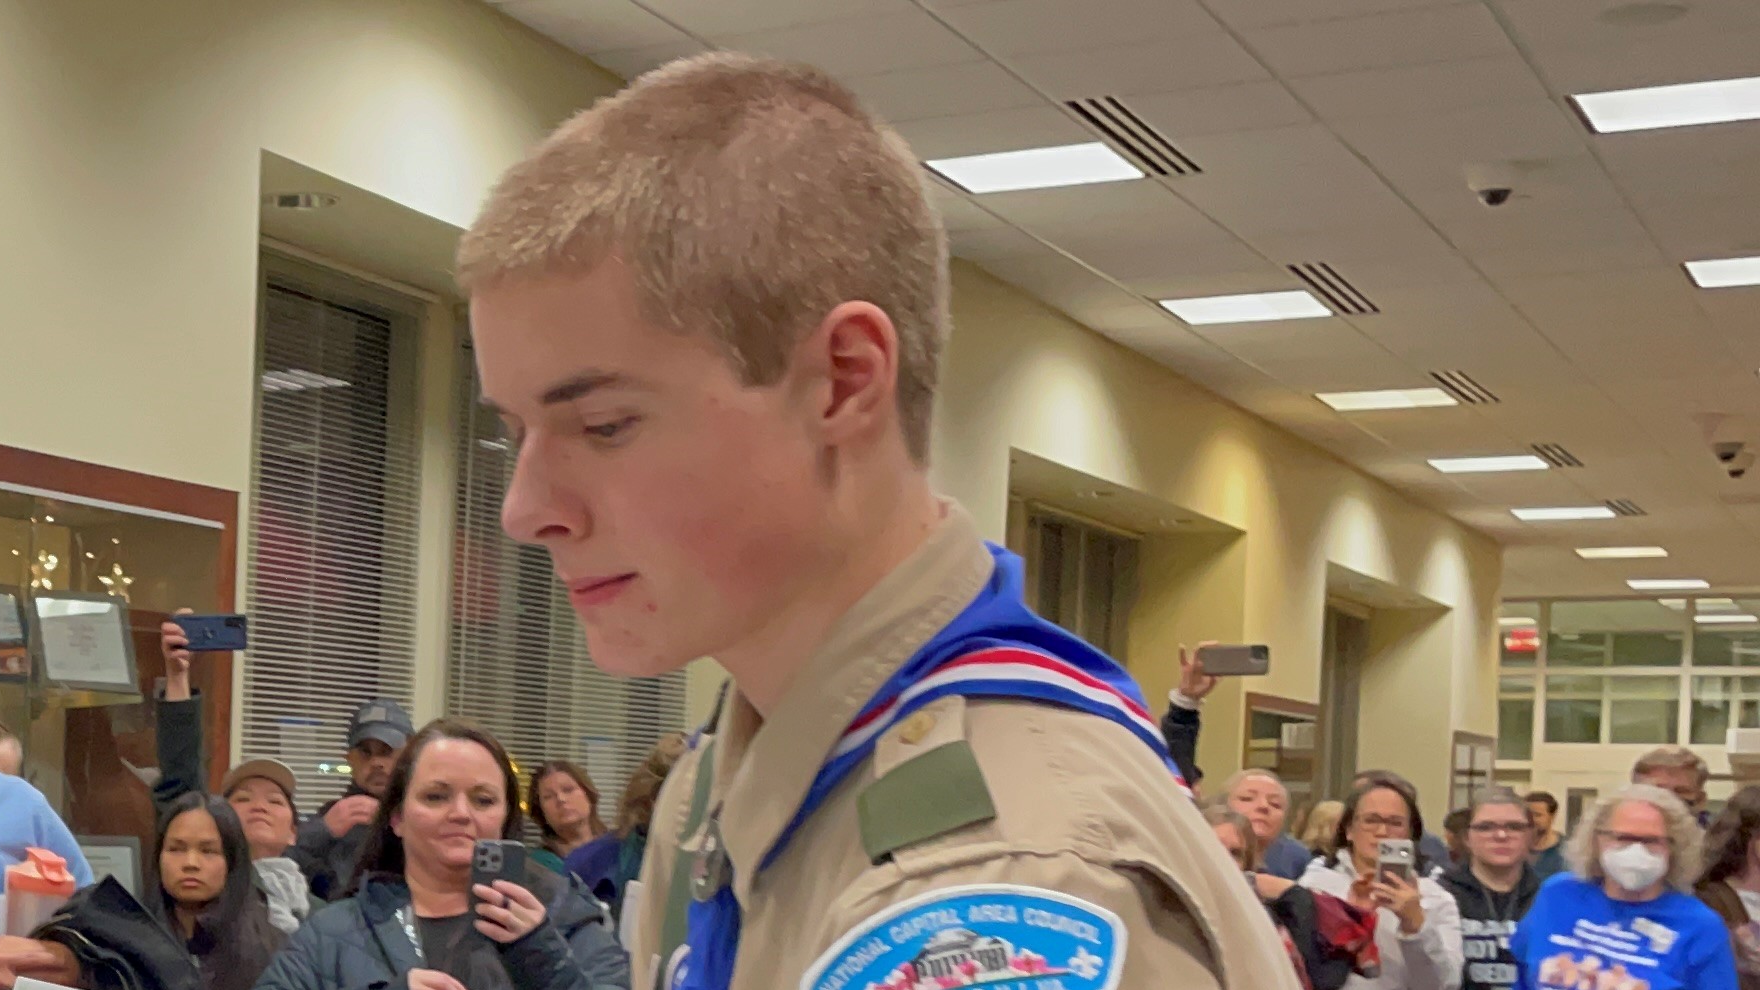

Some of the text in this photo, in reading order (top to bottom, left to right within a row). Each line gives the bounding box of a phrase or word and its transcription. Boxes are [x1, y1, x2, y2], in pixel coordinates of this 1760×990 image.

[889, 908, 965, 944] CAPITAL
[968, 904, 1018, 923] AREA
[1023, 907, 1102, 945] COUNCIL
